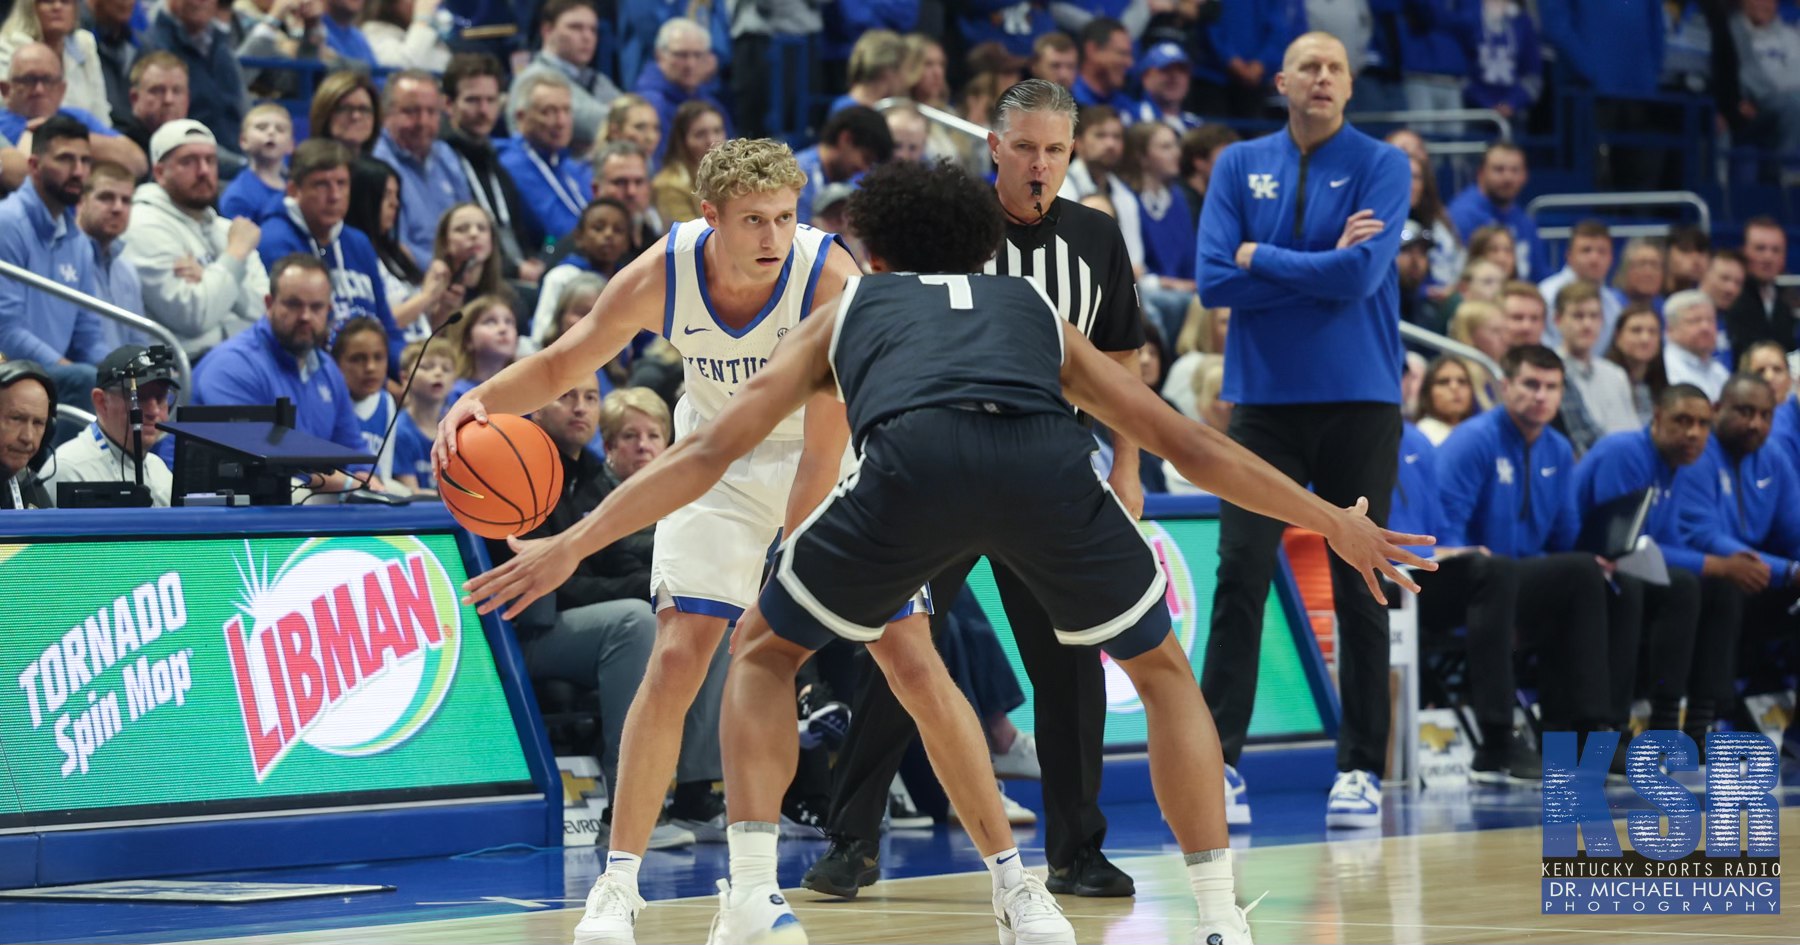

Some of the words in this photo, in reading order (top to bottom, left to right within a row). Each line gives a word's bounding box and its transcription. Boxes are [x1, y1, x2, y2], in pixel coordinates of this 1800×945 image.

[18, 570, 188, 730] TORNADO
[225, 553, 443, 779] LIBMAN
[53, 690, 123, 779] Spin
